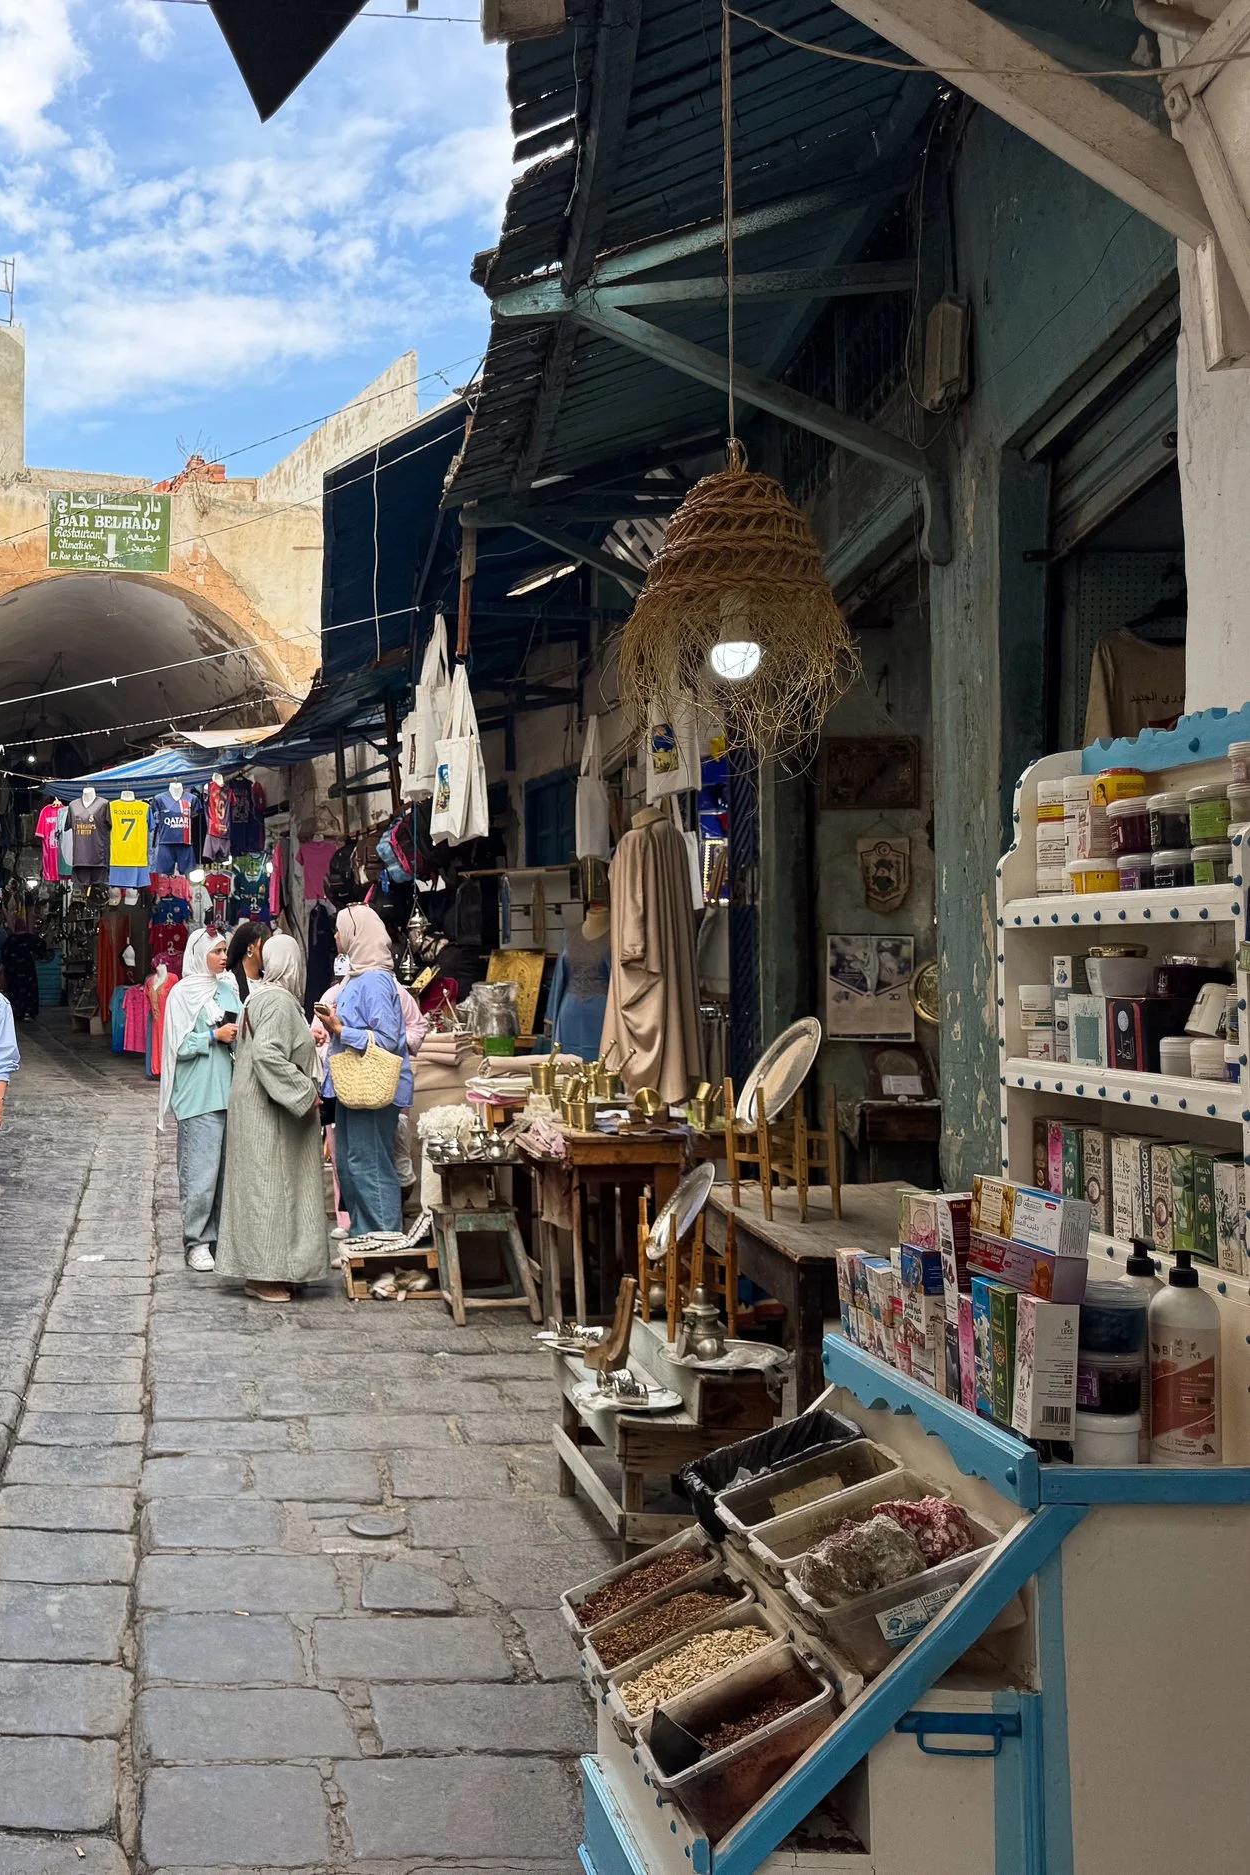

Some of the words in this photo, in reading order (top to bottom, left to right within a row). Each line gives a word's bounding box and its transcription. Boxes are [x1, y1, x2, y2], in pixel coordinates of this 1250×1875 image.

[59, 514, 90, 528] DAR
[94, 515, 161, 531] BELHADJ
[121, 818, 136, 841] 7
[164, 816, 189, 826] QATAR
